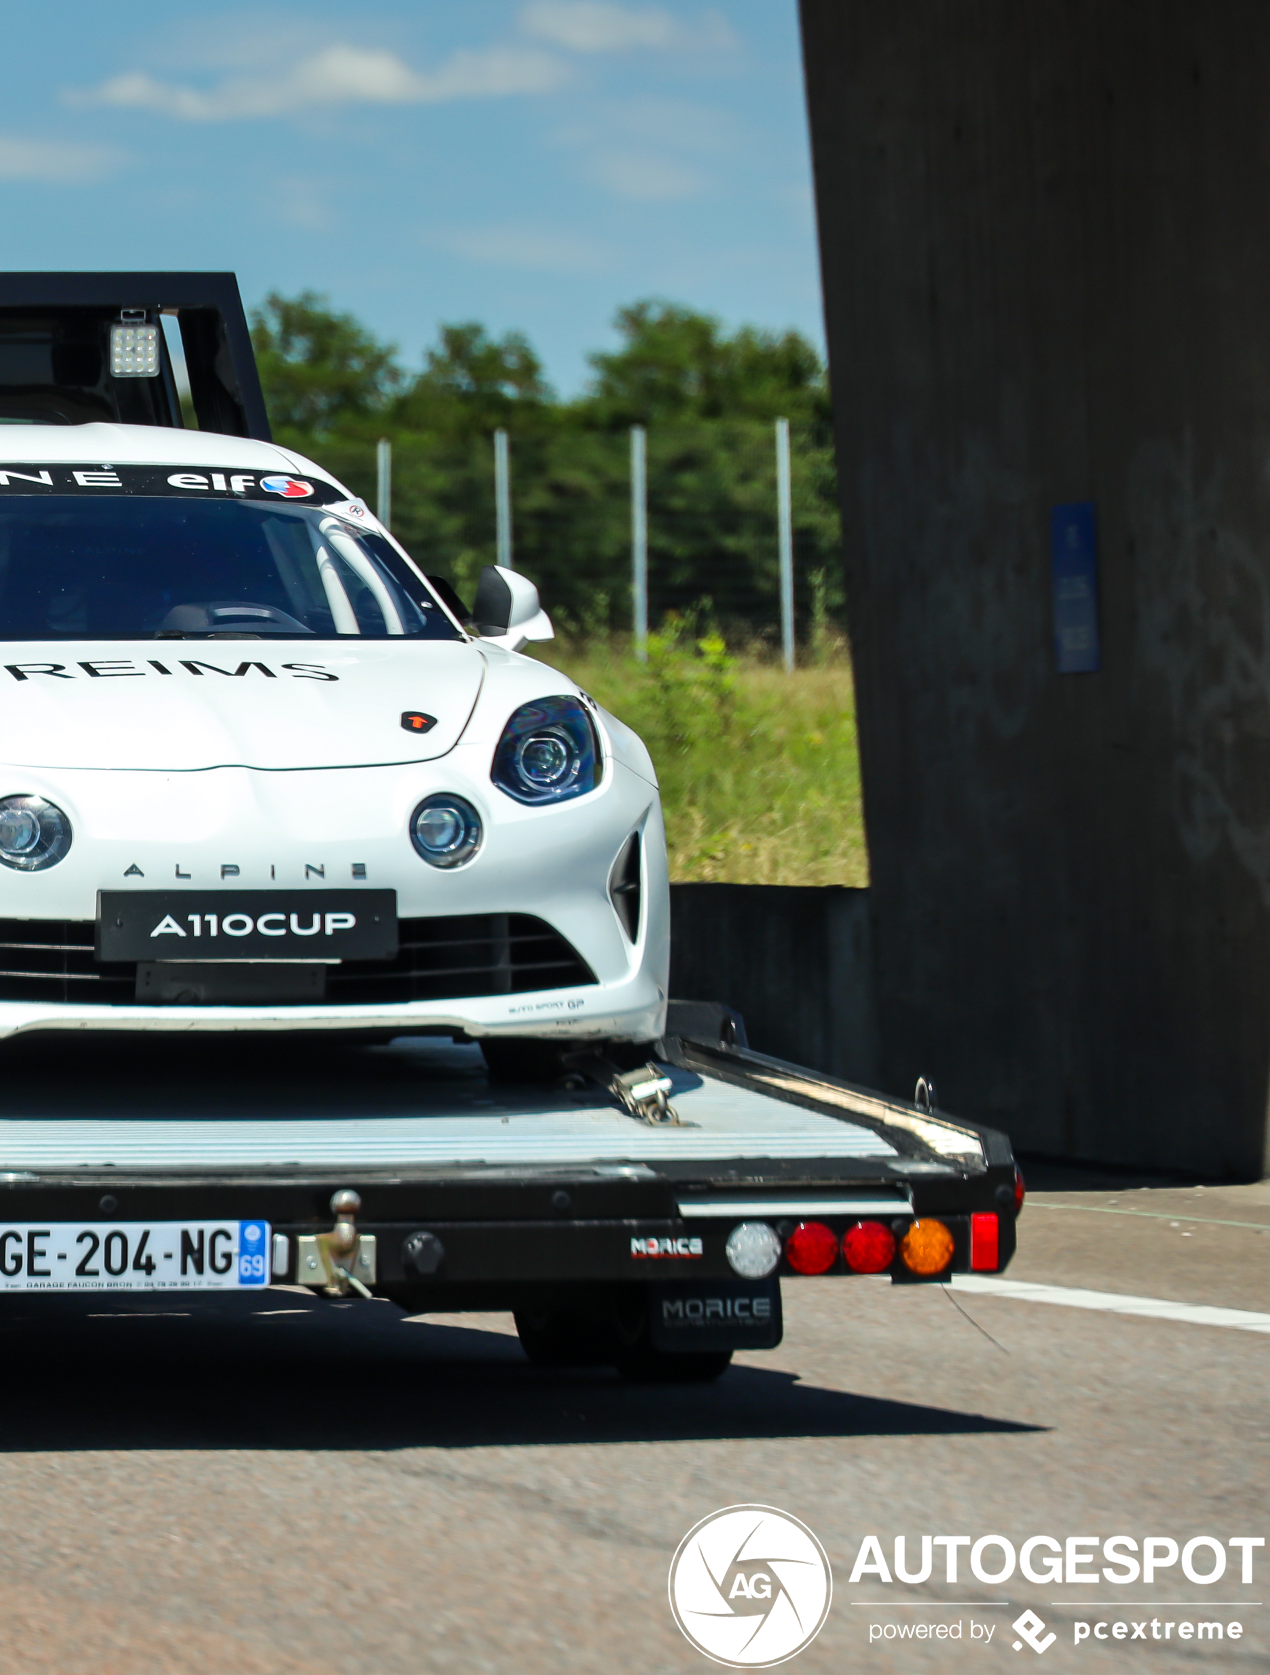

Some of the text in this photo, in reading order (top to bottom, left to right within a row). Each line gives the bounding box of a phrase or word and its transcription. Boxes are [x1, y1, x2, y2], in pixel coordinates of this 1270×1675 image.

[167, 473, 256, 492] elf
[3, 660, 340, 681] REIMS
[123, 863, 367, 880] ALPINE
[150, 913, 357, 938] A110CUP
[240, 1254, 264, 1277] 69
[662, 1298, 771, 1318] MORICE
